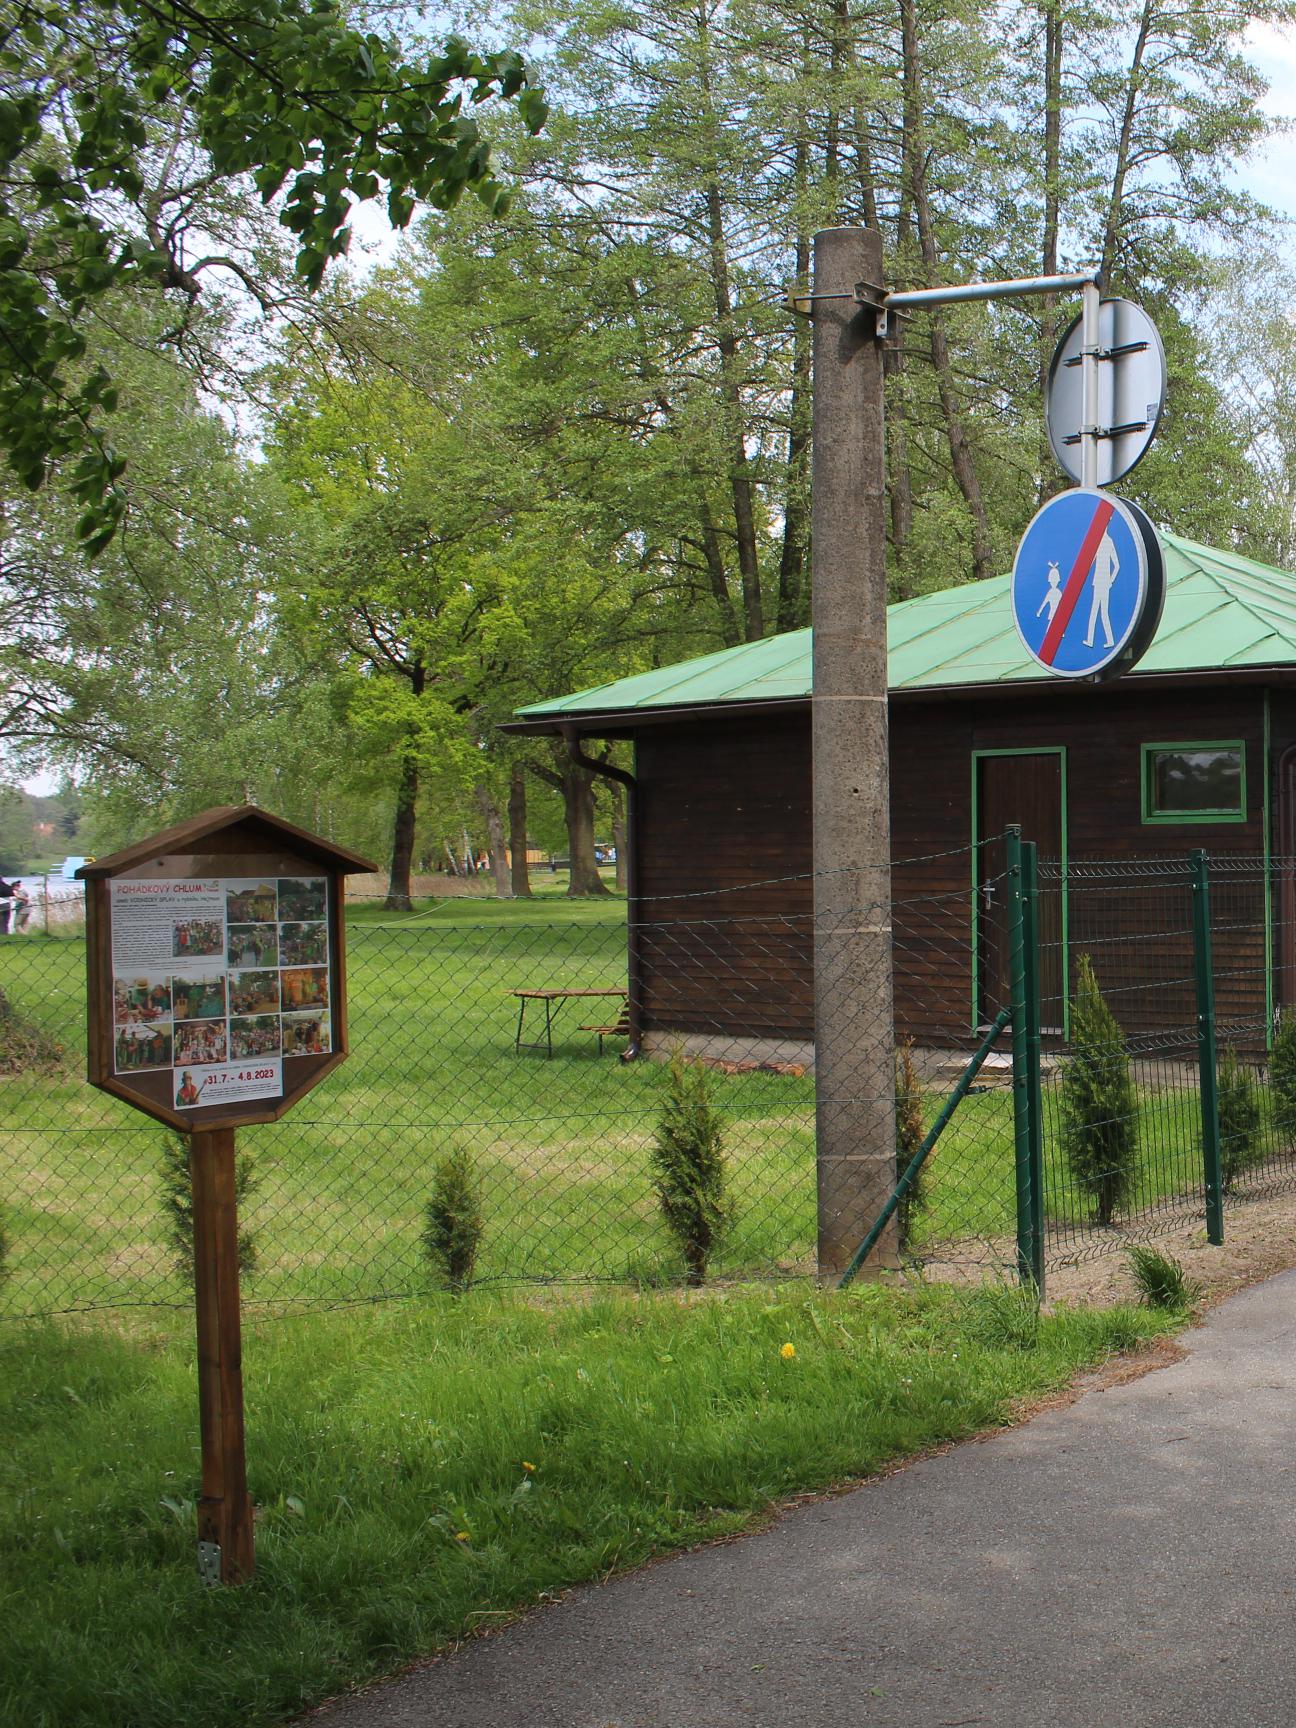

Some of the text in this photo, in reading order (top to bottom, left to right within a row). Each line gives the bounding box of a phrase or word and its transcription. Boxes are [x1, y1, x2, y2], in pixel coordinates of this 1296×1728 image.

[116, 882, 170, 894] POHÁDKOVÝ
[173, 884, 203, 893] CHLUM
[238, 1069, 274, 1081] 4.8.2023
